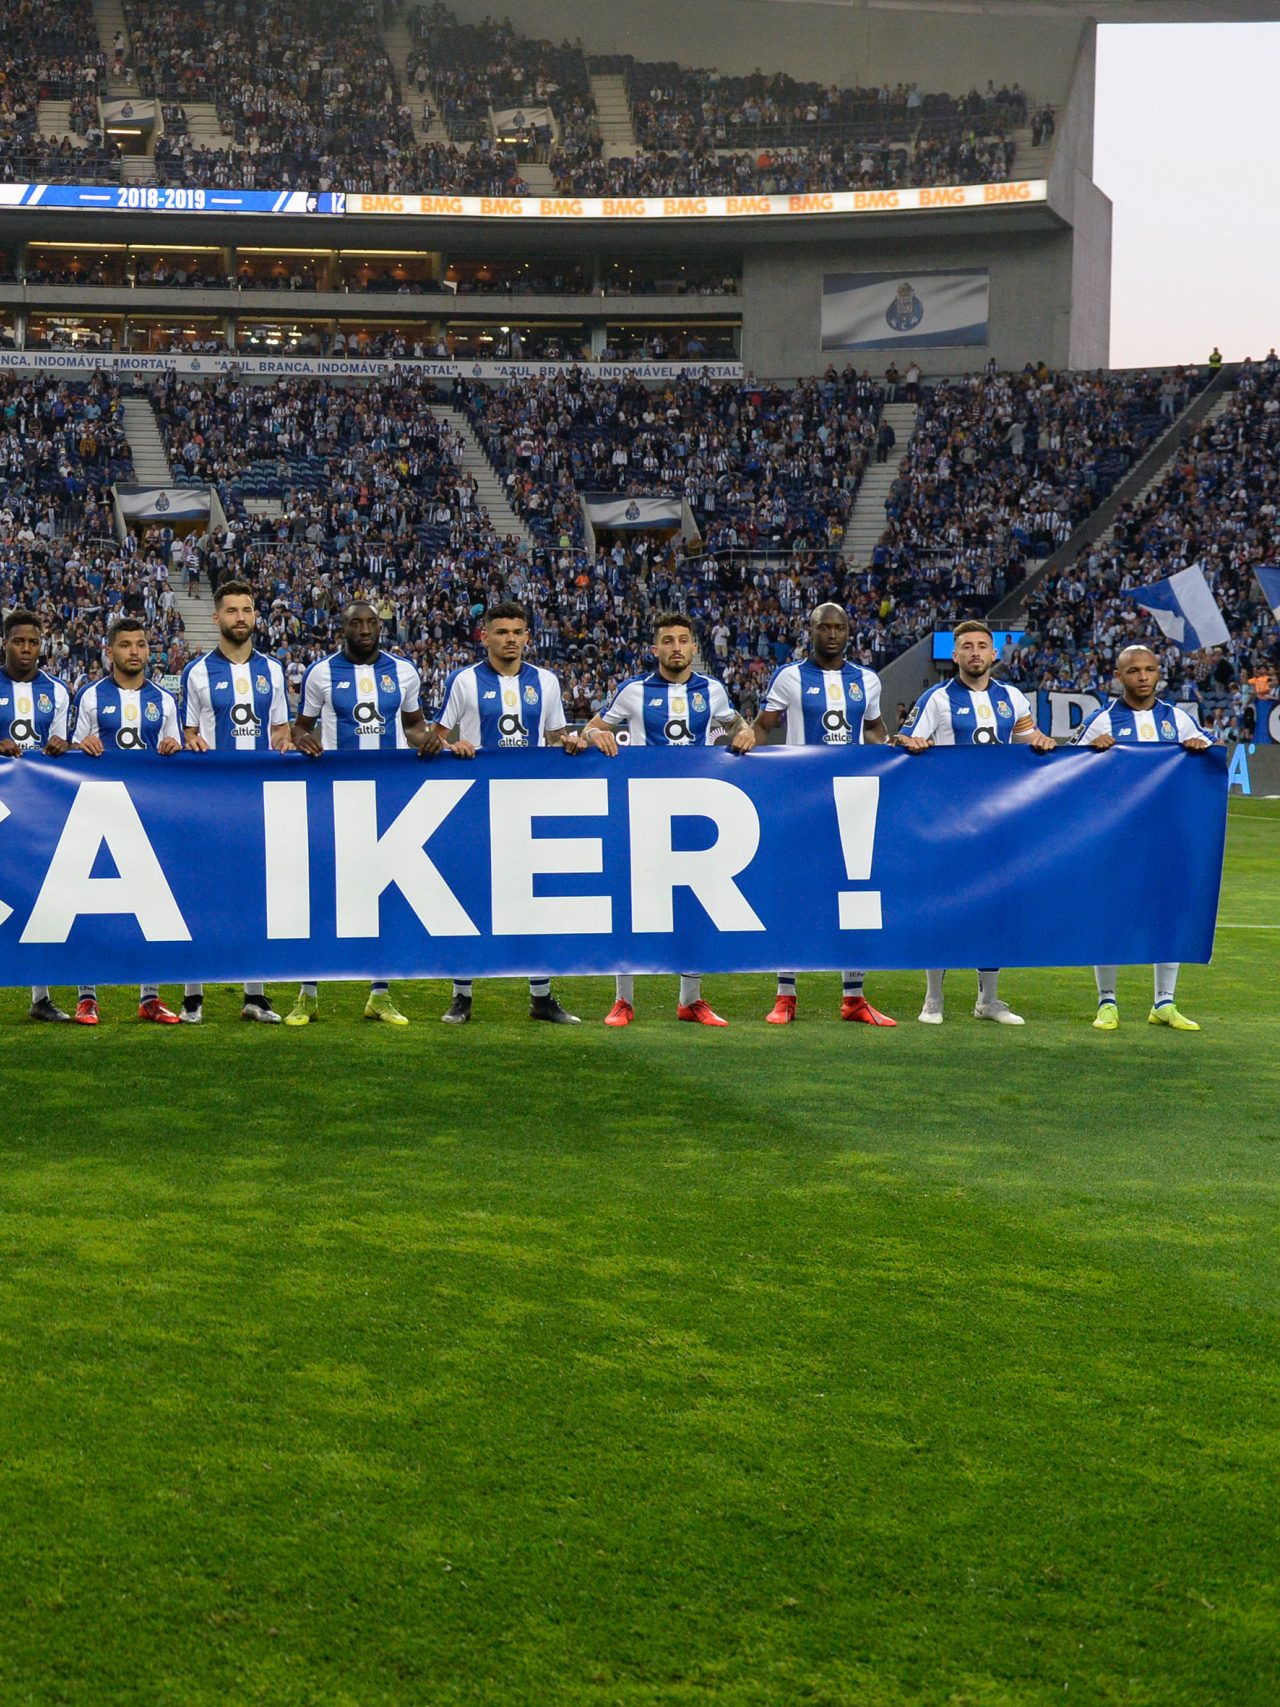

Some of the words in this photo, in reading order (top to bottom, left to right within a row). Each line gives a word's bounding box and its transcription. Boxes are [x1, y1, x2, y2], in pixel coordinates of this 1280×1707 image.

[117, 187, 206, 209] 2018-2019
[361, 195, 404, 212] BMG
[420, 196, 463, 214] BMG
[480, 198, 522, 214] BMG
[540, 199, 583, 216] BMG
[602, 199, 645, 216] BMG
[664, 198, 707, 215] BMG
[726, 197, 771, 214] BMG
[789, 194, 833, 212] BMG
[854, 192, 899, 209] BMG
[919, 188, 965, 206] BMG
[984, 183, 1030, 202] BMG
[231, 725, 261, 737] altice
[355, 724, 385, 735] altice
[498, 737, 528, 747] altice
[823, 732, 852, 744] altice
[264, 778, 766, 938] IKER
[833, 777, 882, 929] !
